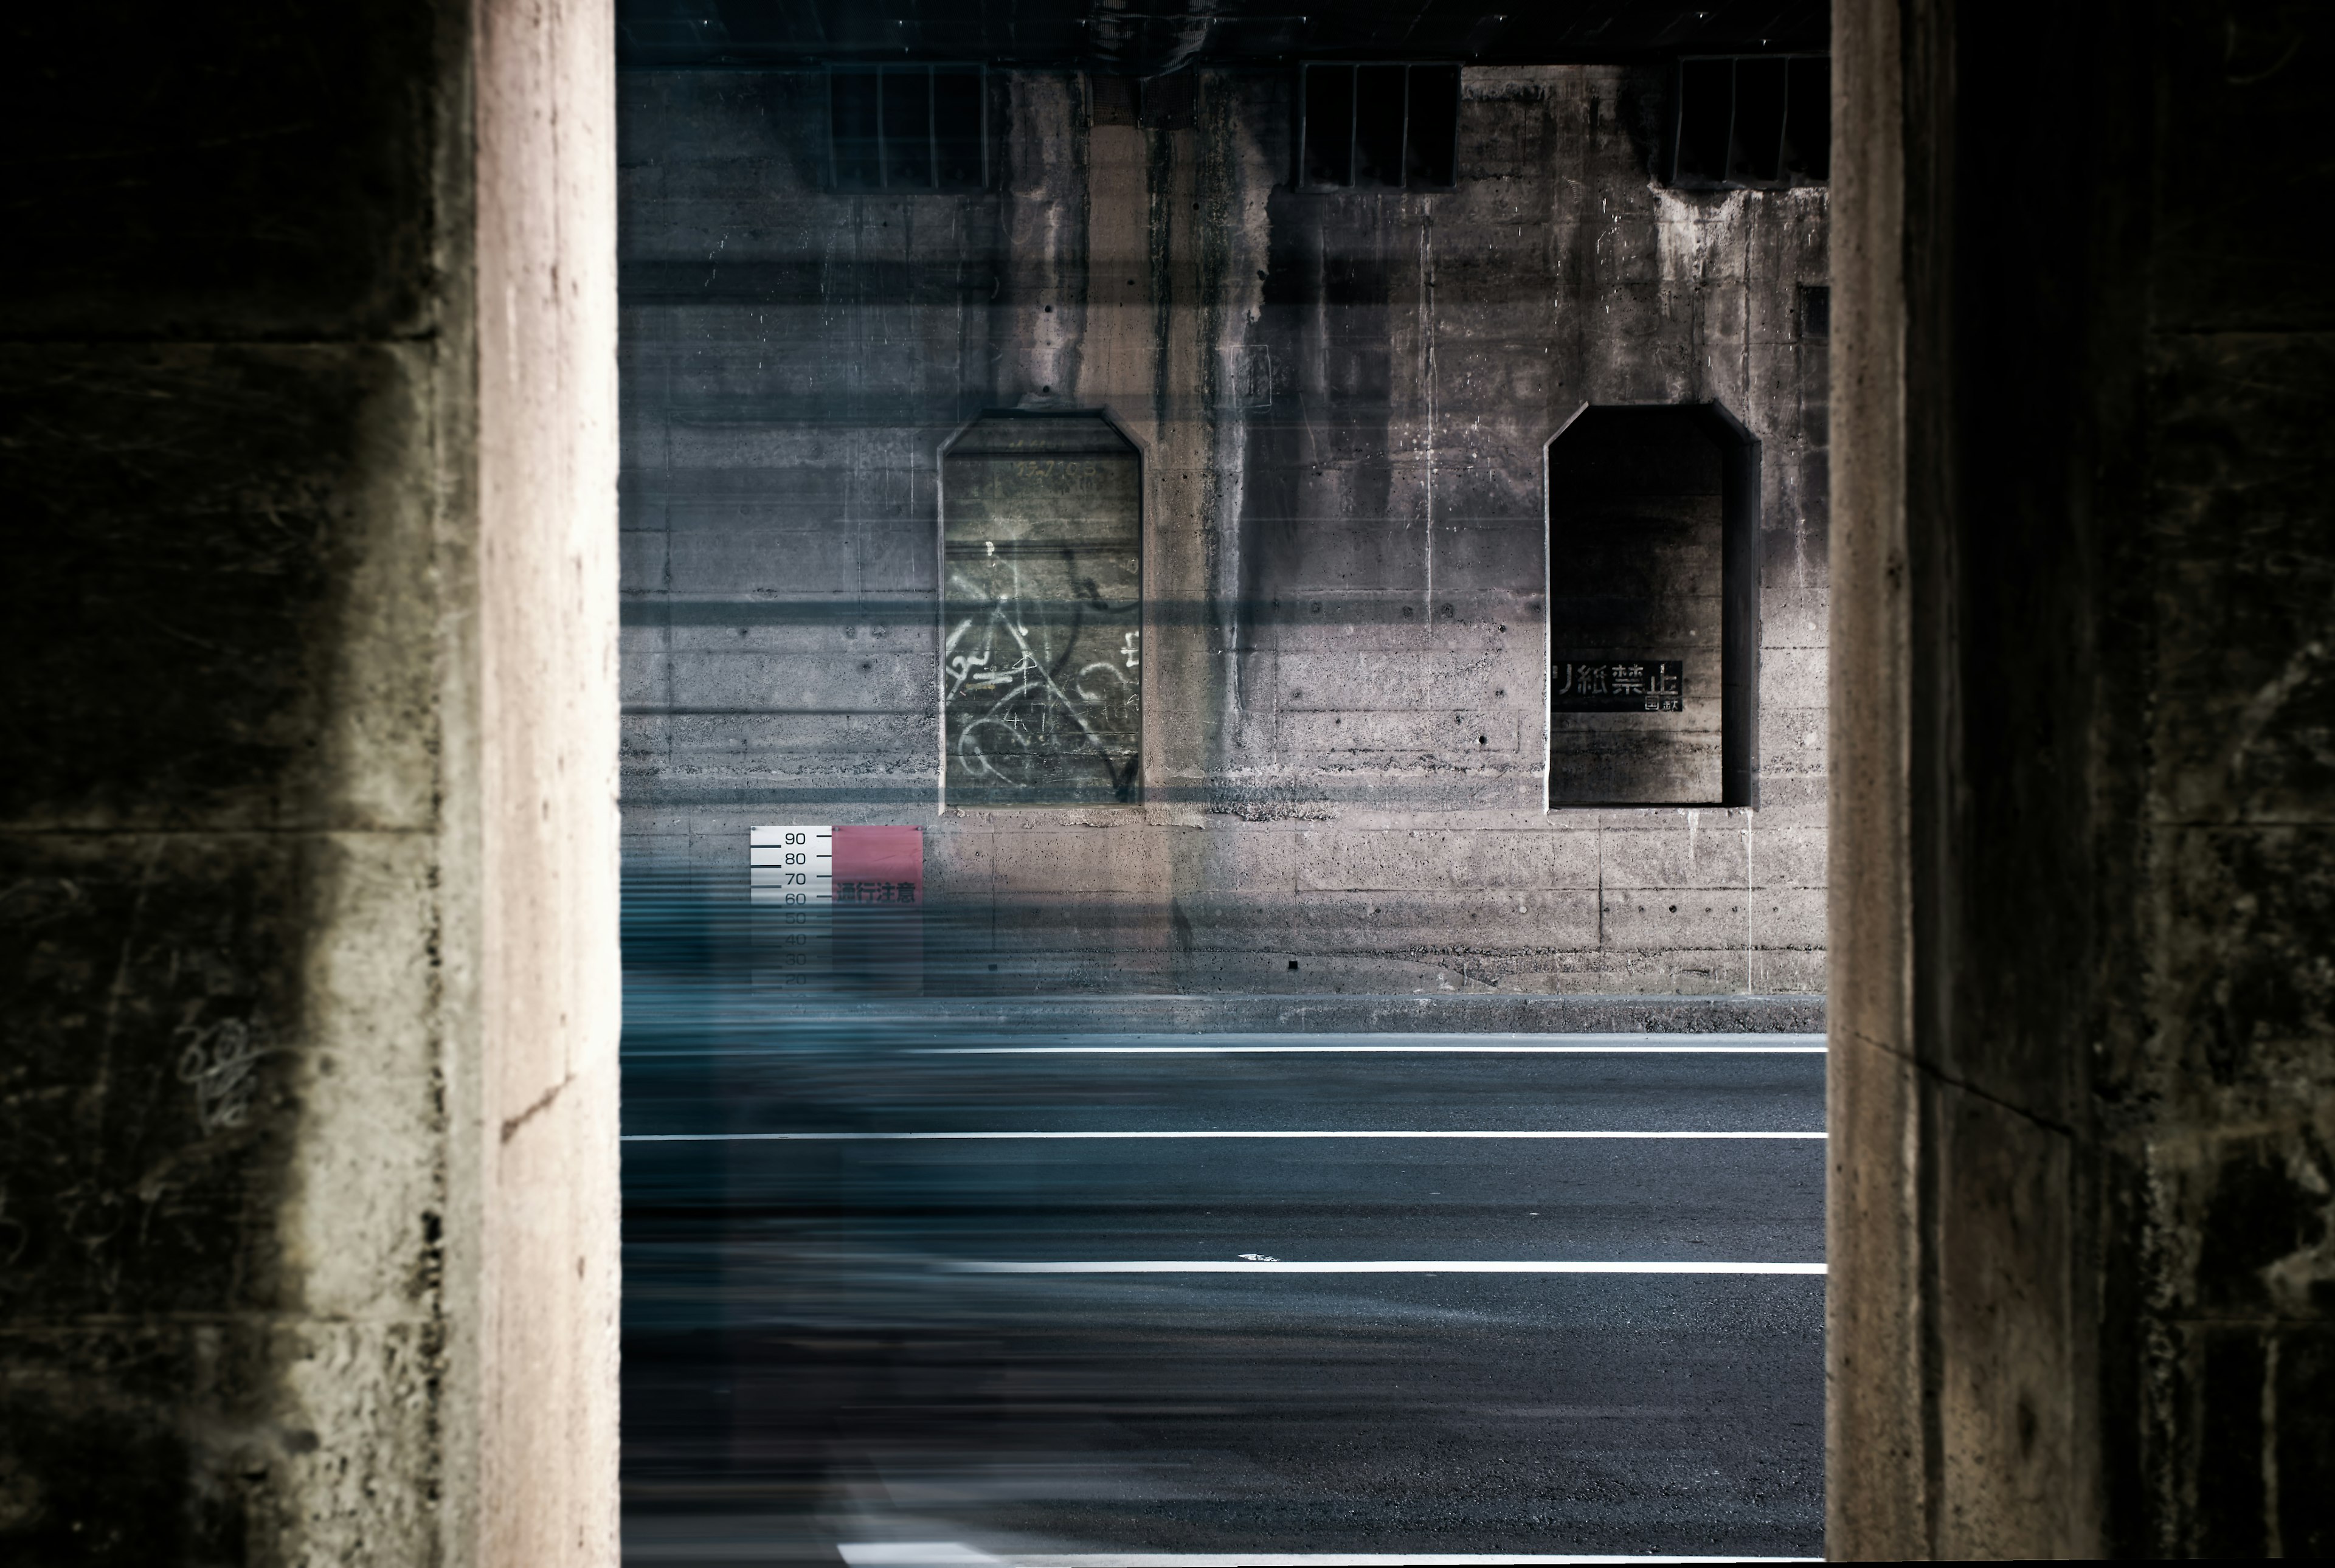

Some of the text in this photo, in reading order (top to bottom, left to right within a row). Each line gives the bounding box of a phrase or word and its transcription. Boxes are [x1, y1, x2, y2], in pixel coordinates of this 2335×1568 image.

[785, 833, 806, 845] 90
[785, 853, 806, 865] 80
[785, 873, 806, 885] 70
[785, 893, 806, 905] 60
[837, 882, 915, 904] 通行注意
[785, 913, 806, 924] 50
[785, 934, 806, 945] 40
[785, 953, 806, 965] 30
[785, 974, 806, 986] 20
